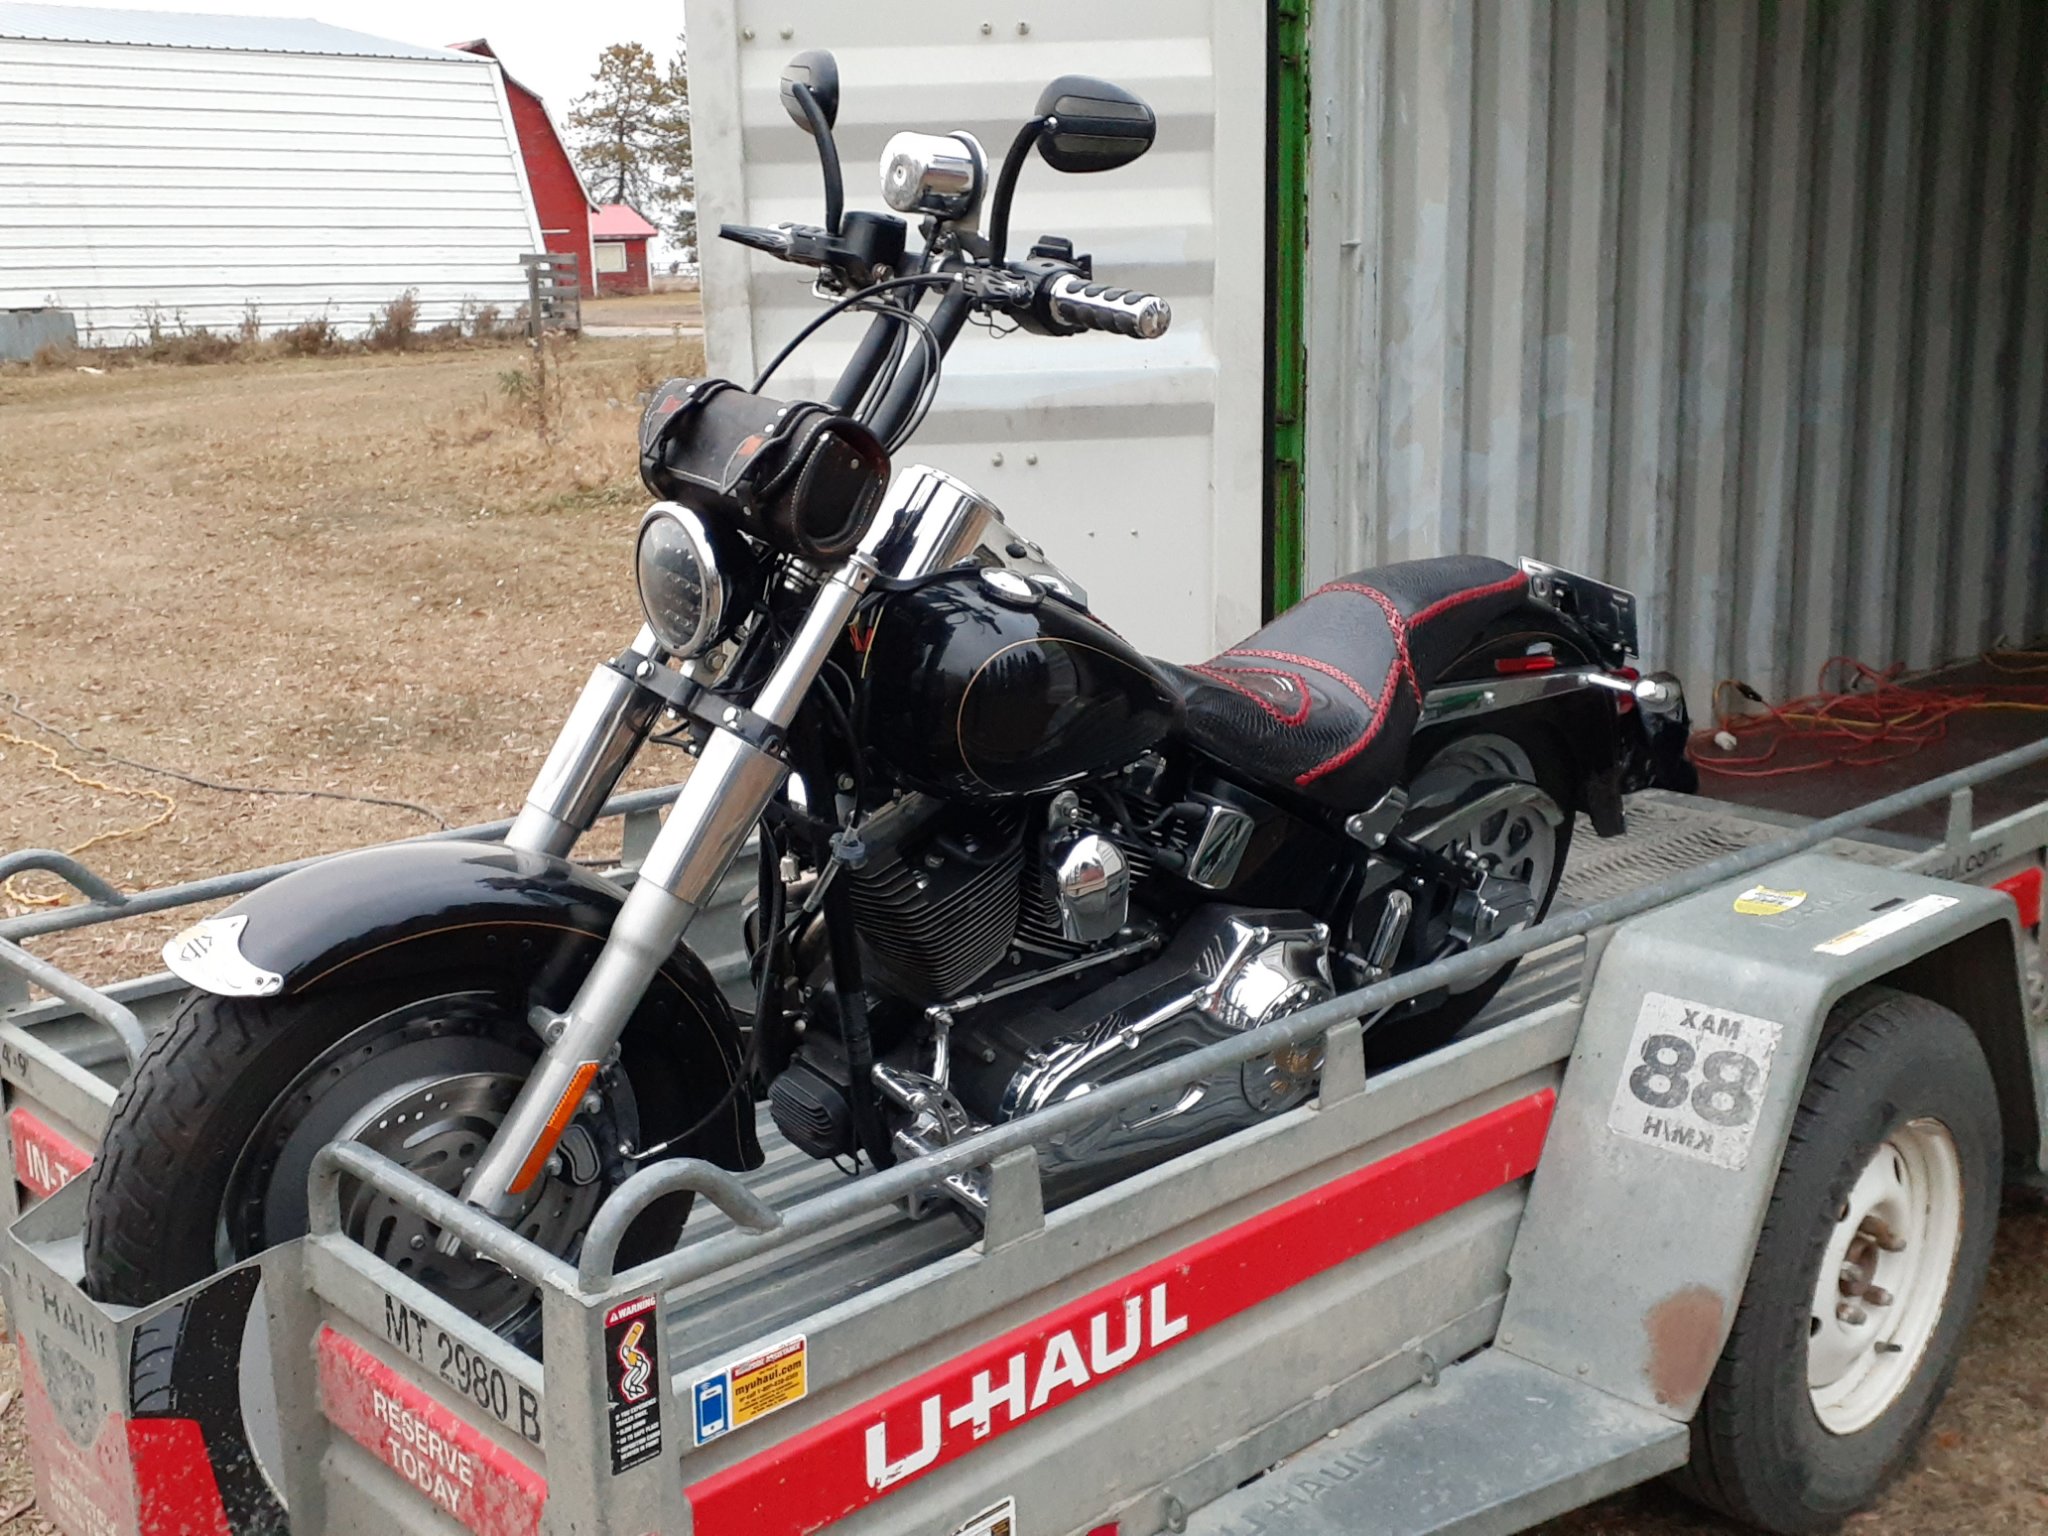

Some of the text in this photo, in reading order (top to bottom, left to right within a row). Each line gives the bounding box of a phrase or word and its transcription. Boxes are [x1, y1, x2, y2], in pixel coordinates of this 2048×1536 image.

[618, 1297, 656, 1319] WARNING
[385, 1293, 541, 1444] MT 2980 B
[735, 1360, 801, 1395] myuhaul.com
[865, 1283, 1188, 1490] U-HAUL
[373, 1389, 473, 1488] RESERVE
[387, 1437, 460, 1512] TODAY
